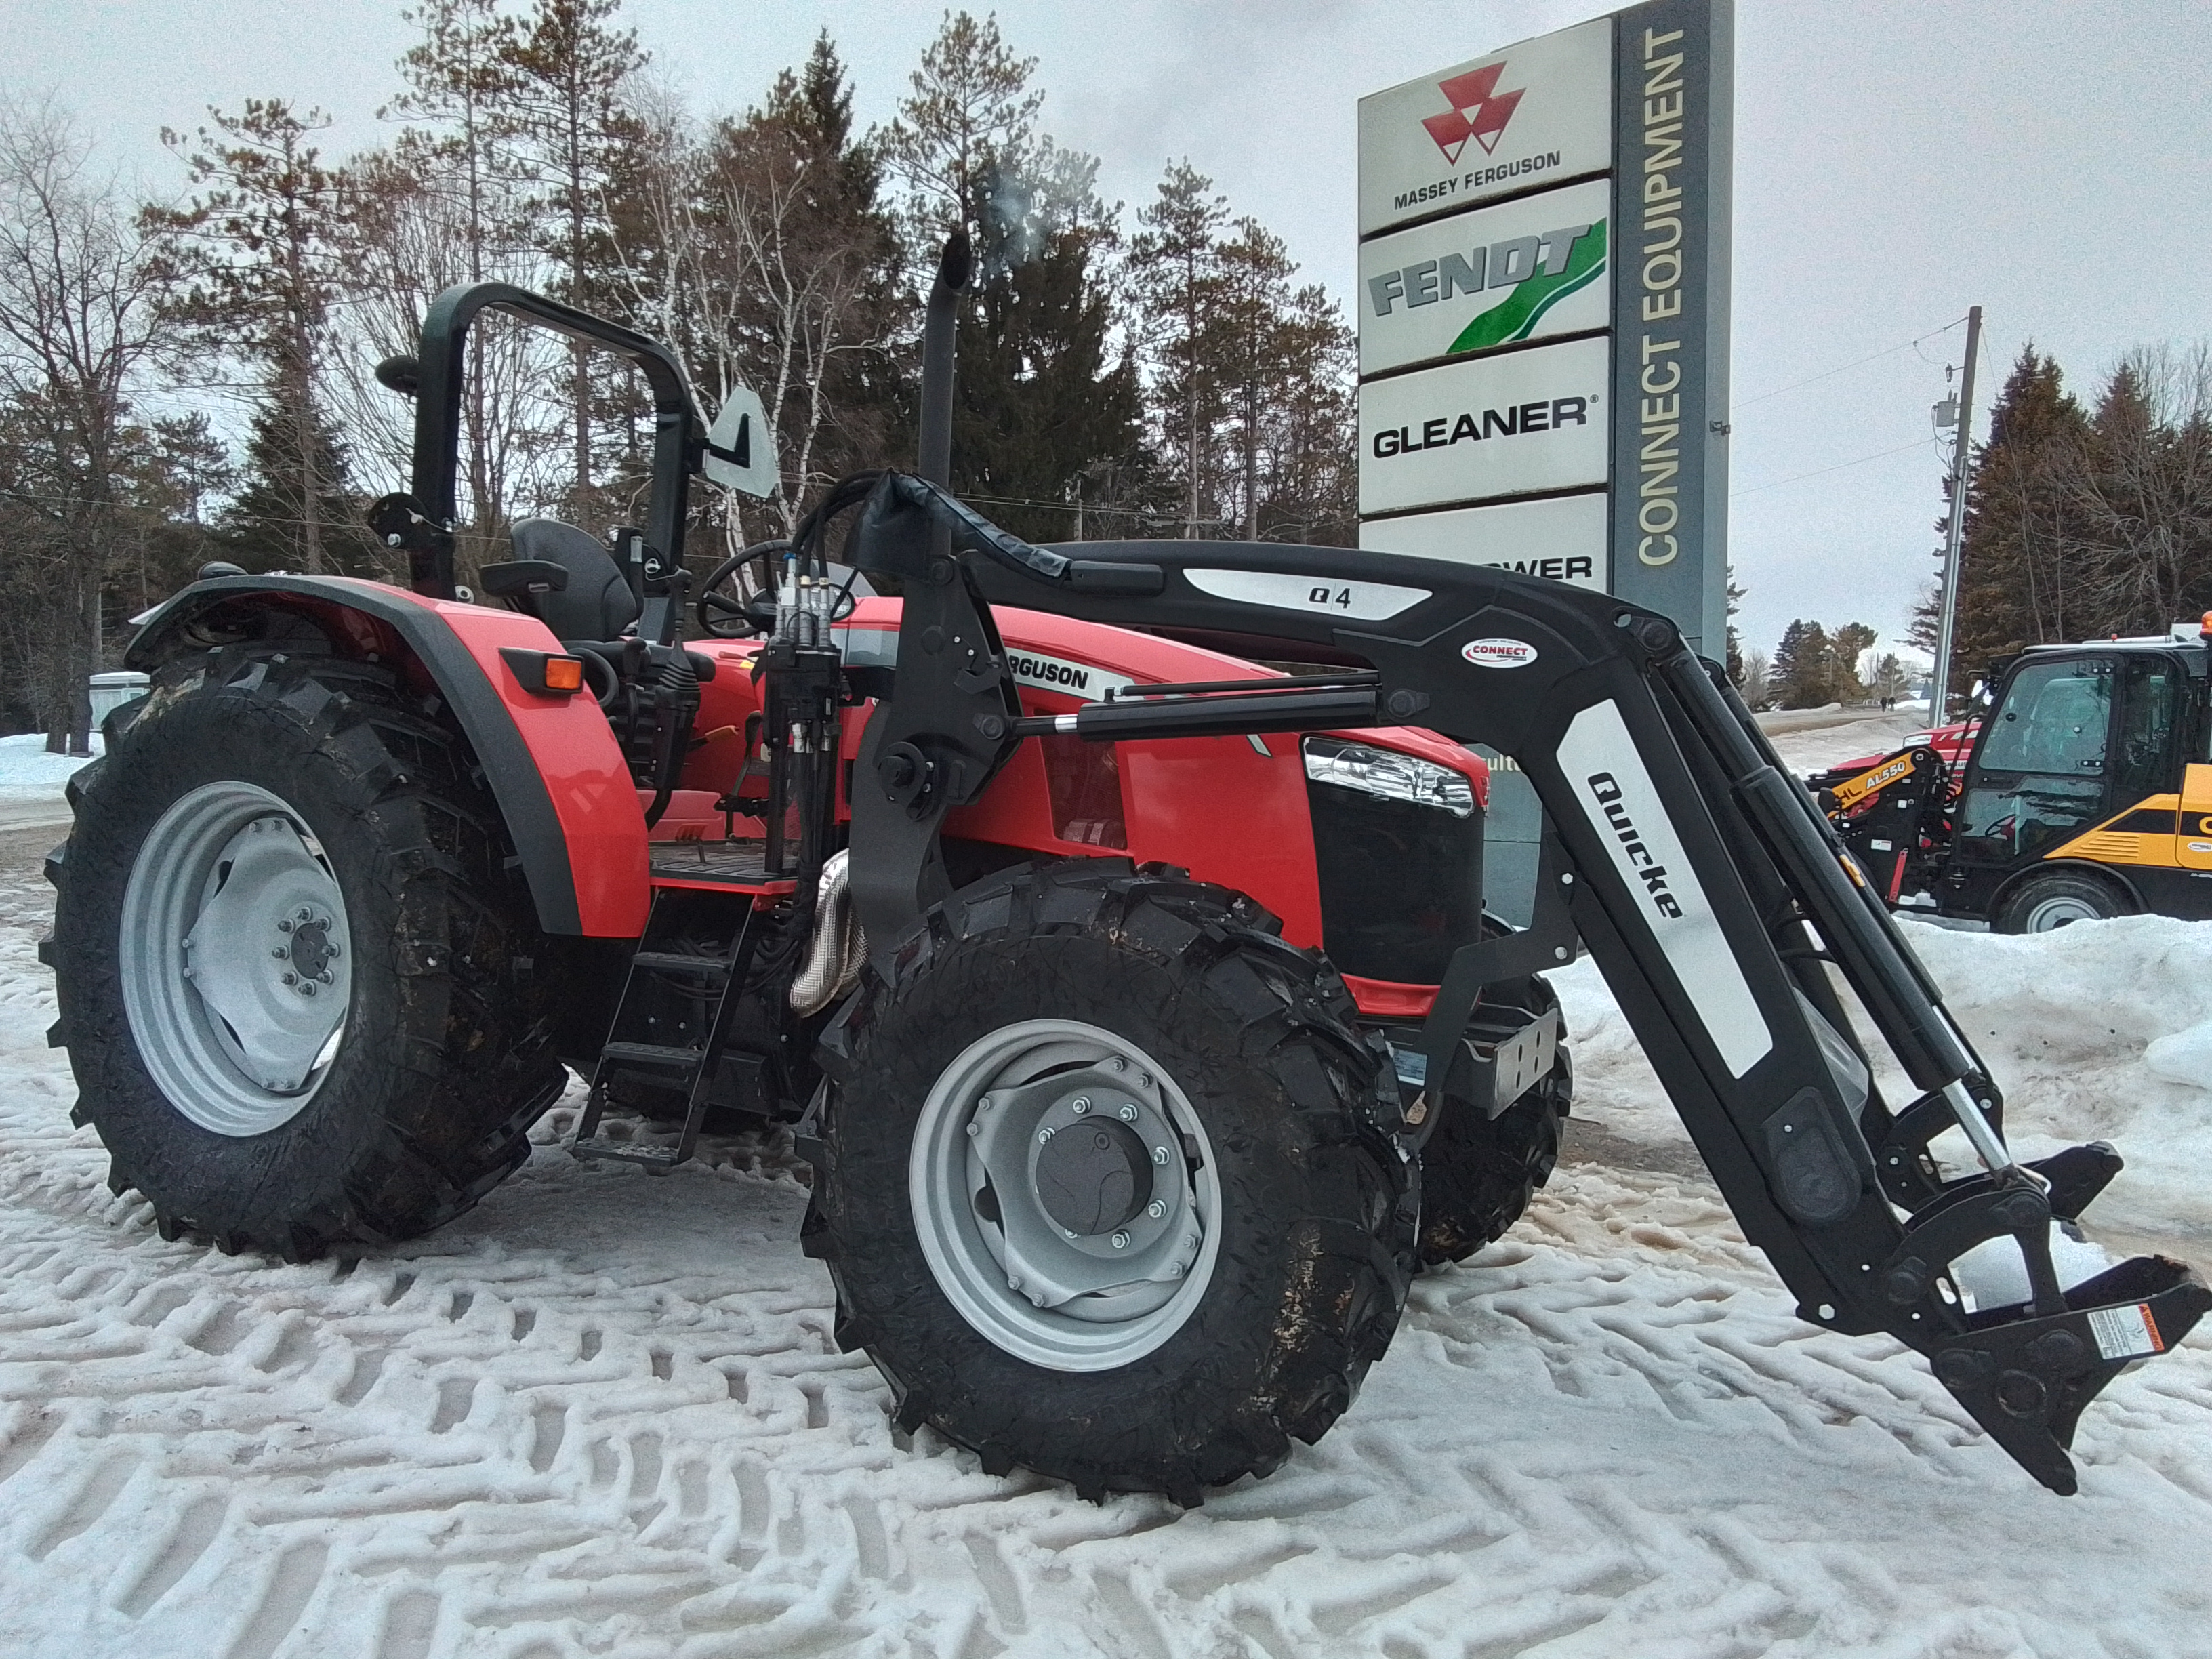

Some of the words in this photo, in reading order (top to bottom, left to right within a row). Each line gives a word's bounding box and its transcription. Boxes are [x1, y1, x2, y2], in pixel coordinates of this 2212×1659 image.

[1394, 177, 1458, 210] MASSEY
[1465, 150, 1560, 190] FERGUSON
[1642, 27, 1684, 321] EQUIPMENT
[1367, 224, 1593, 316] FENDT
[1638, 335, 1681, 567] CONNECT
[1008, 655, 1089, 691] RGUSON
[1473, 645, 1528, 656] CONNECT
[1866, 762, 1906, 790] AL550
[1587, 772, 1683, 920] Quicke
